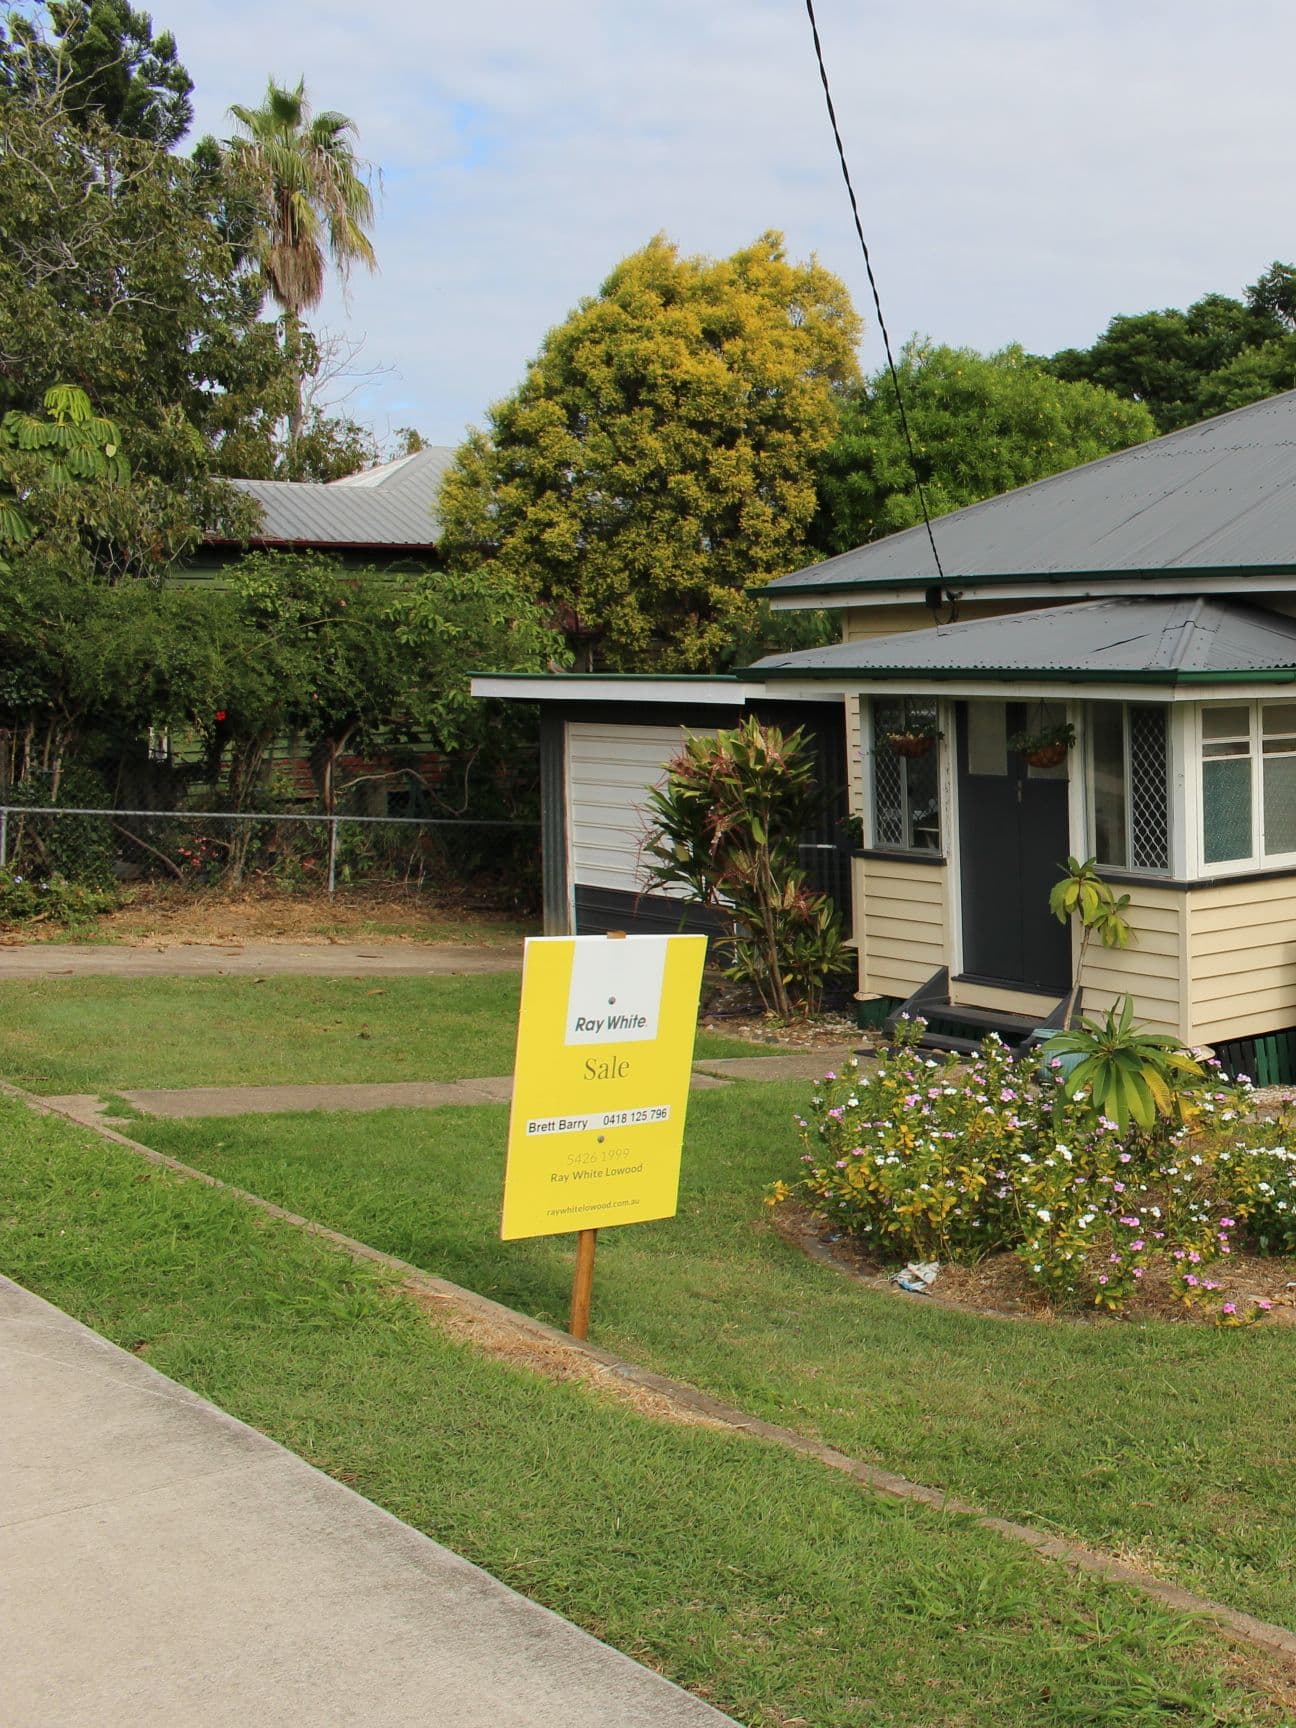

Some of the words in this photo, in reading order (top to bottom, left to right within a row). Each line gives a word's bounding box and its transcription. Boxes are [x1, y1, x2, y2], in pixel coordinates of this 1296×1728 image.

[575, 1016, 604, 1034] Ray
[607, 1014, 647, 1030] White
[584, 1056, 630, 1081] Sale
[528, 1120, 555, 1133] Brett
[558, 1118, 588, 1131] Barry
[603, 1113, 627, 1126] 0418
[630, 1110, 647, 1123] 125
[650, 1108, 667, 1121] 796
[550, 1172, 569, 1183] Ray
[573, 1168, 603, 1180] White
[605, 1164, 642, 1176] Lowood
[546, 1198, 640, 1217] raywhitelowood.com.au
